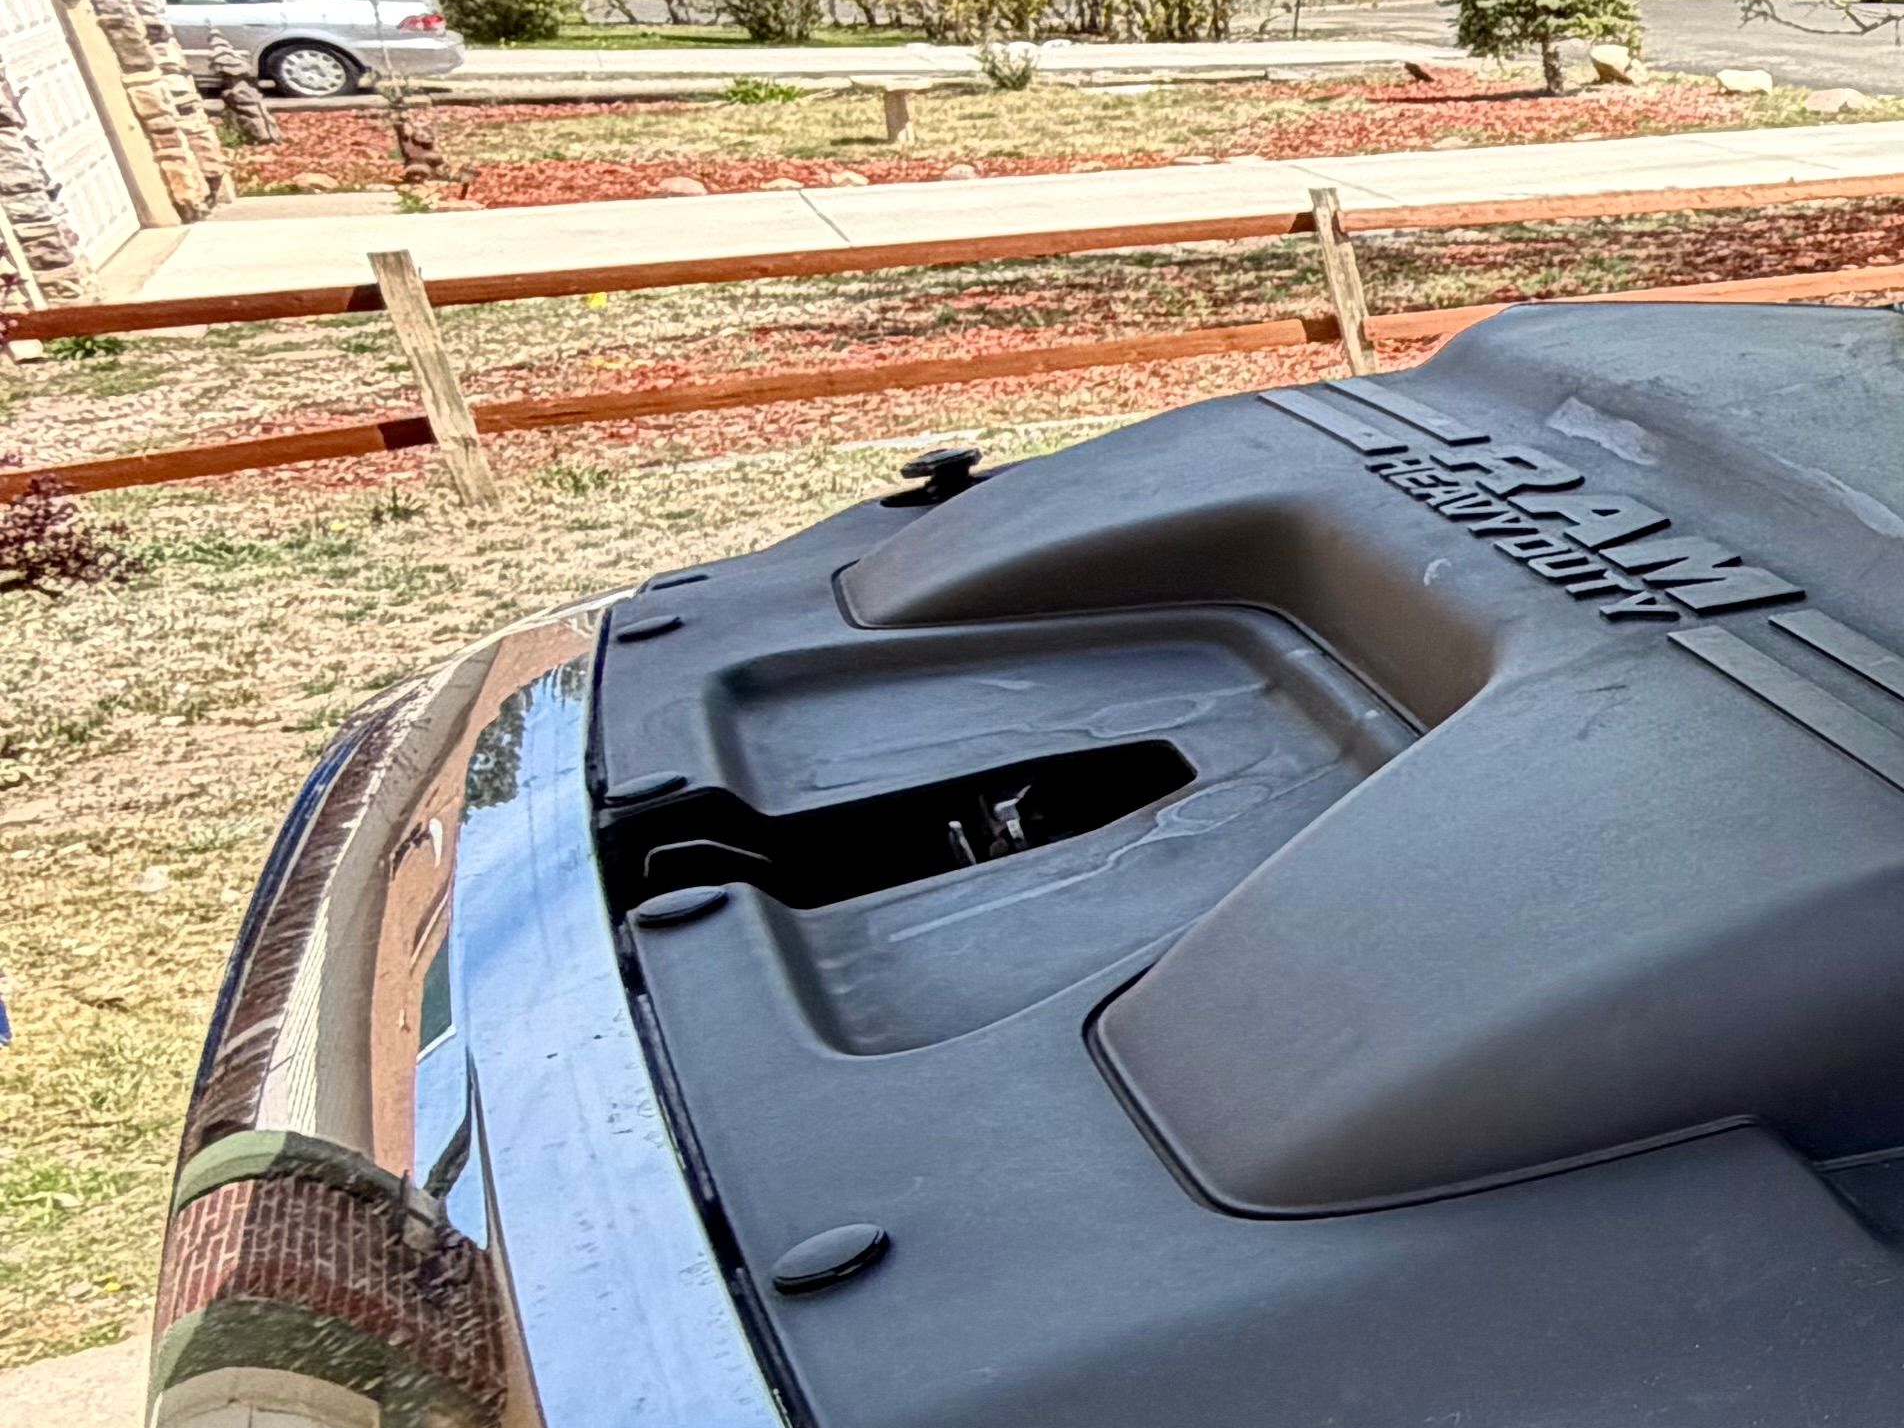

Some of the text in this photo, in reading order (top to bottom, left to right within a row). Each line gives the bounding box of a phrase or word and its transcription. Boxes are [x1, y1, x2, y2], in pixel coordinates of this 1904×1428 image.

[1364, 456, 1681, 623] HEAVY DUTY
[1430, 445, 1808, 616] RAM
